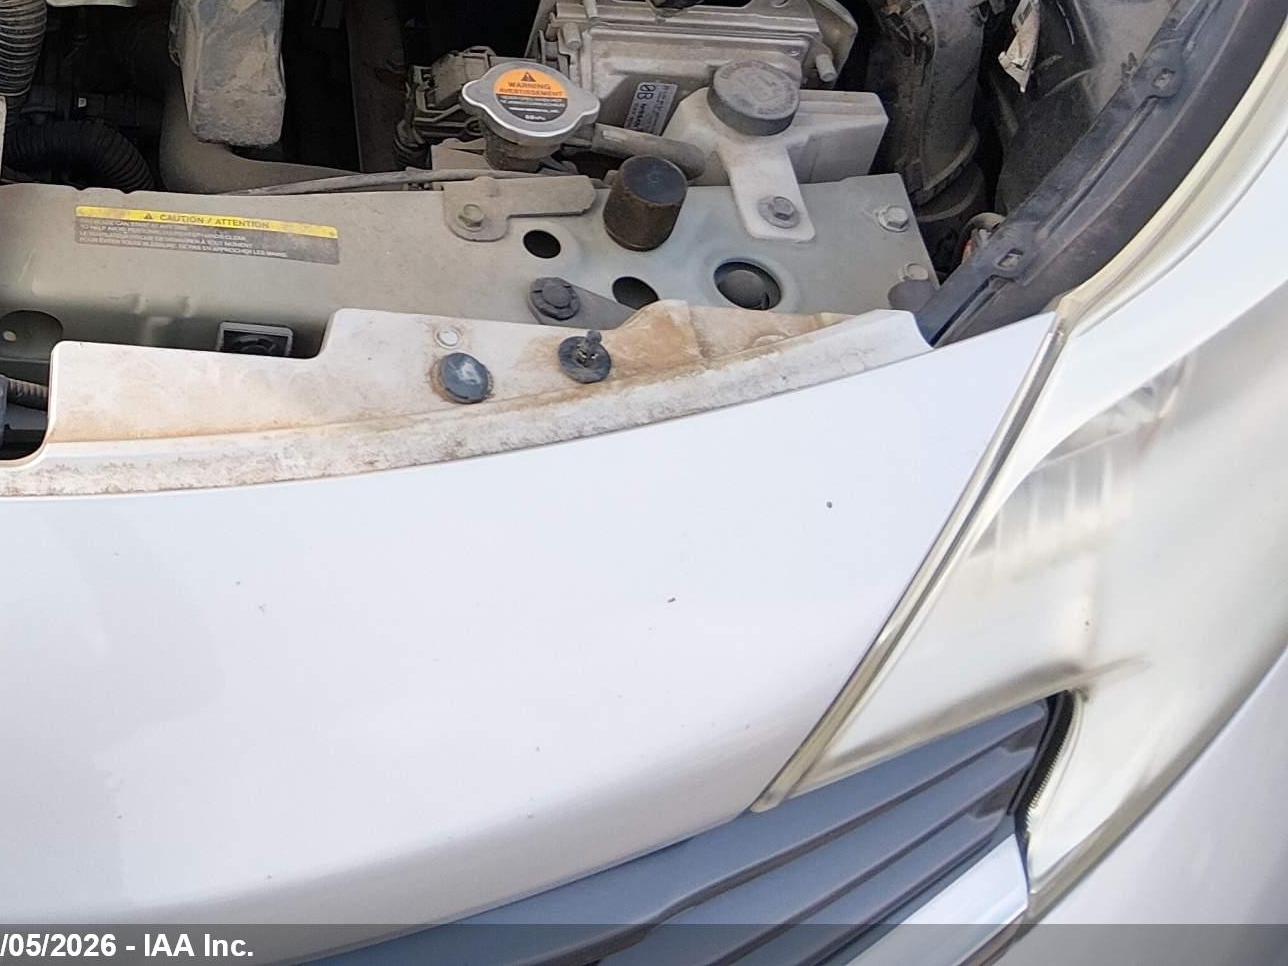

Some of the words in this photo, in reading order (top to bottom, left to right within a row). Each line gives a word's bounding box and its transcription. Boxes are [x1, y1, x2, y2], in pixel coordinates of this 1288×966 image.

[507, 81, 552, 90] WARNING
[159, 213, 205, 224] CAUTION
[215, 218, 271, 229] ATTENTION
